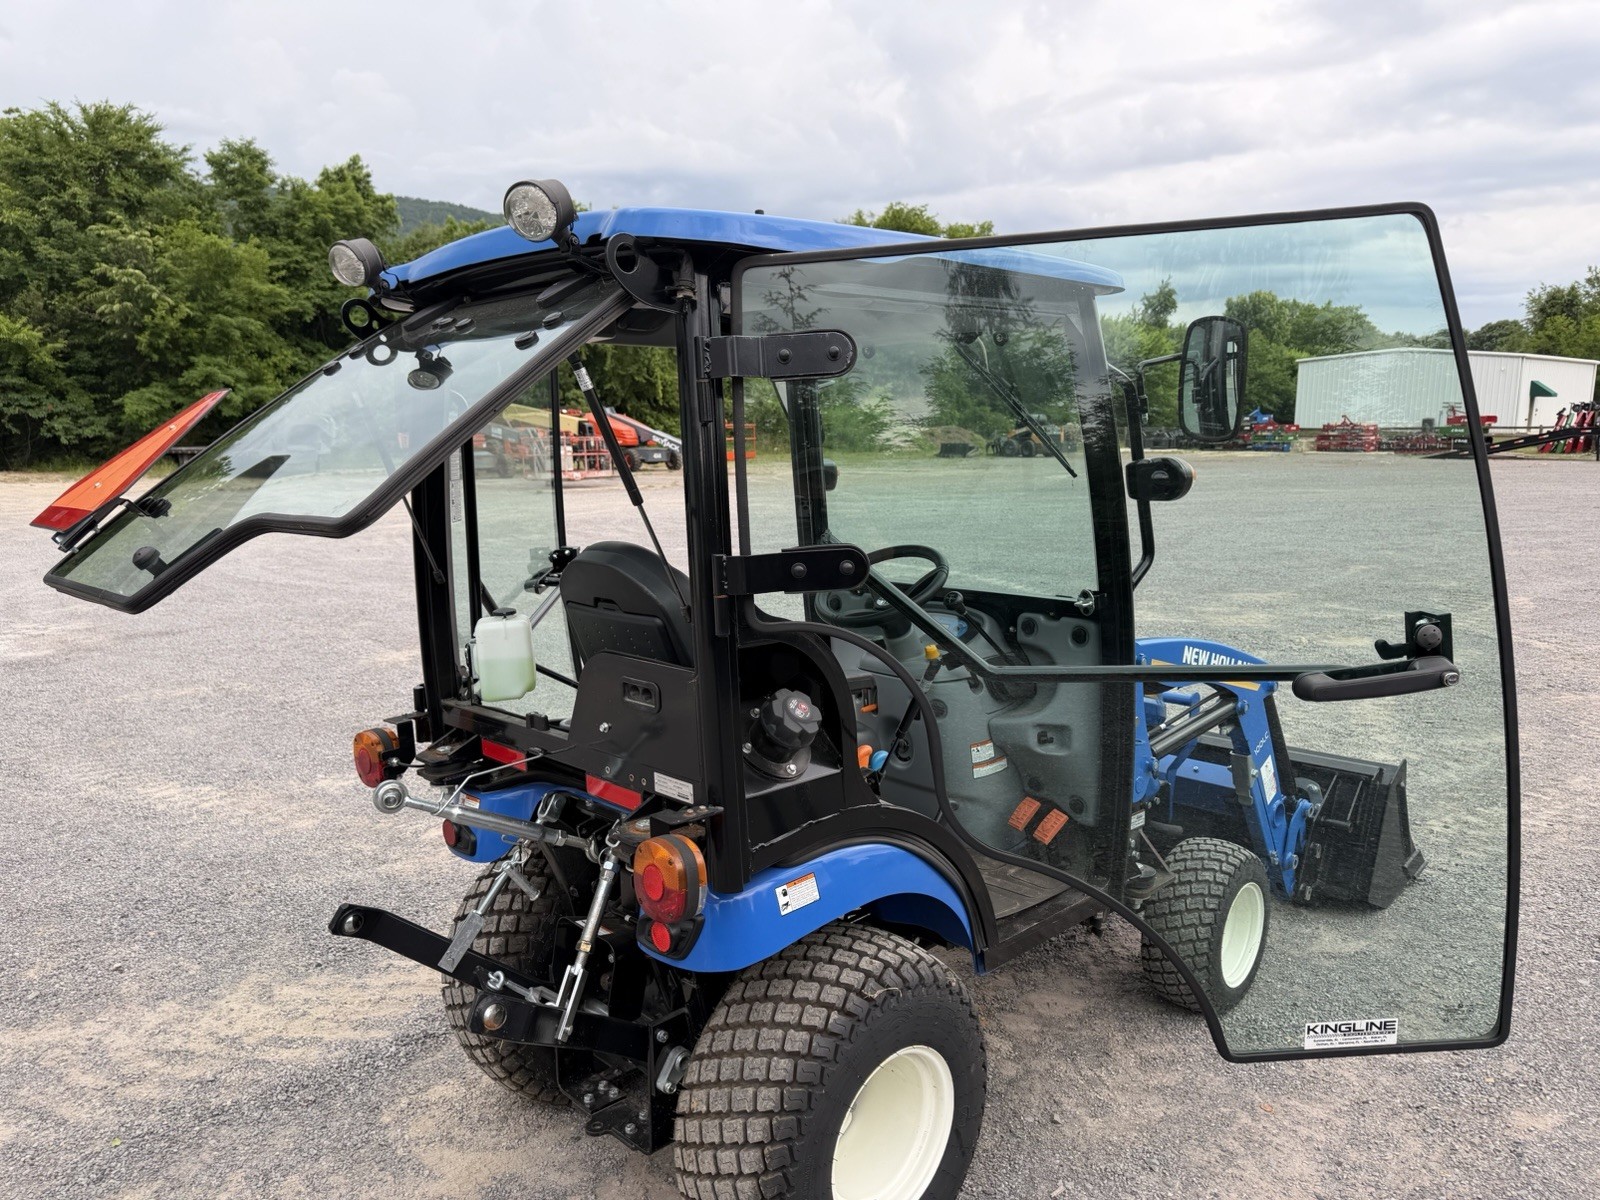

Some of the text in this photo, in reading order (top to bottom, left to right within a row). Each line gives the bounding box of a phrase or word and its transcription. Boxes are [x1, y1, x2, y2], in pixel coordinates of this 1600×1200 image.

[1182, 645, 1256, 666] NEW HOLL
[1307, 1020, 1397, 1035] KINGLINE
